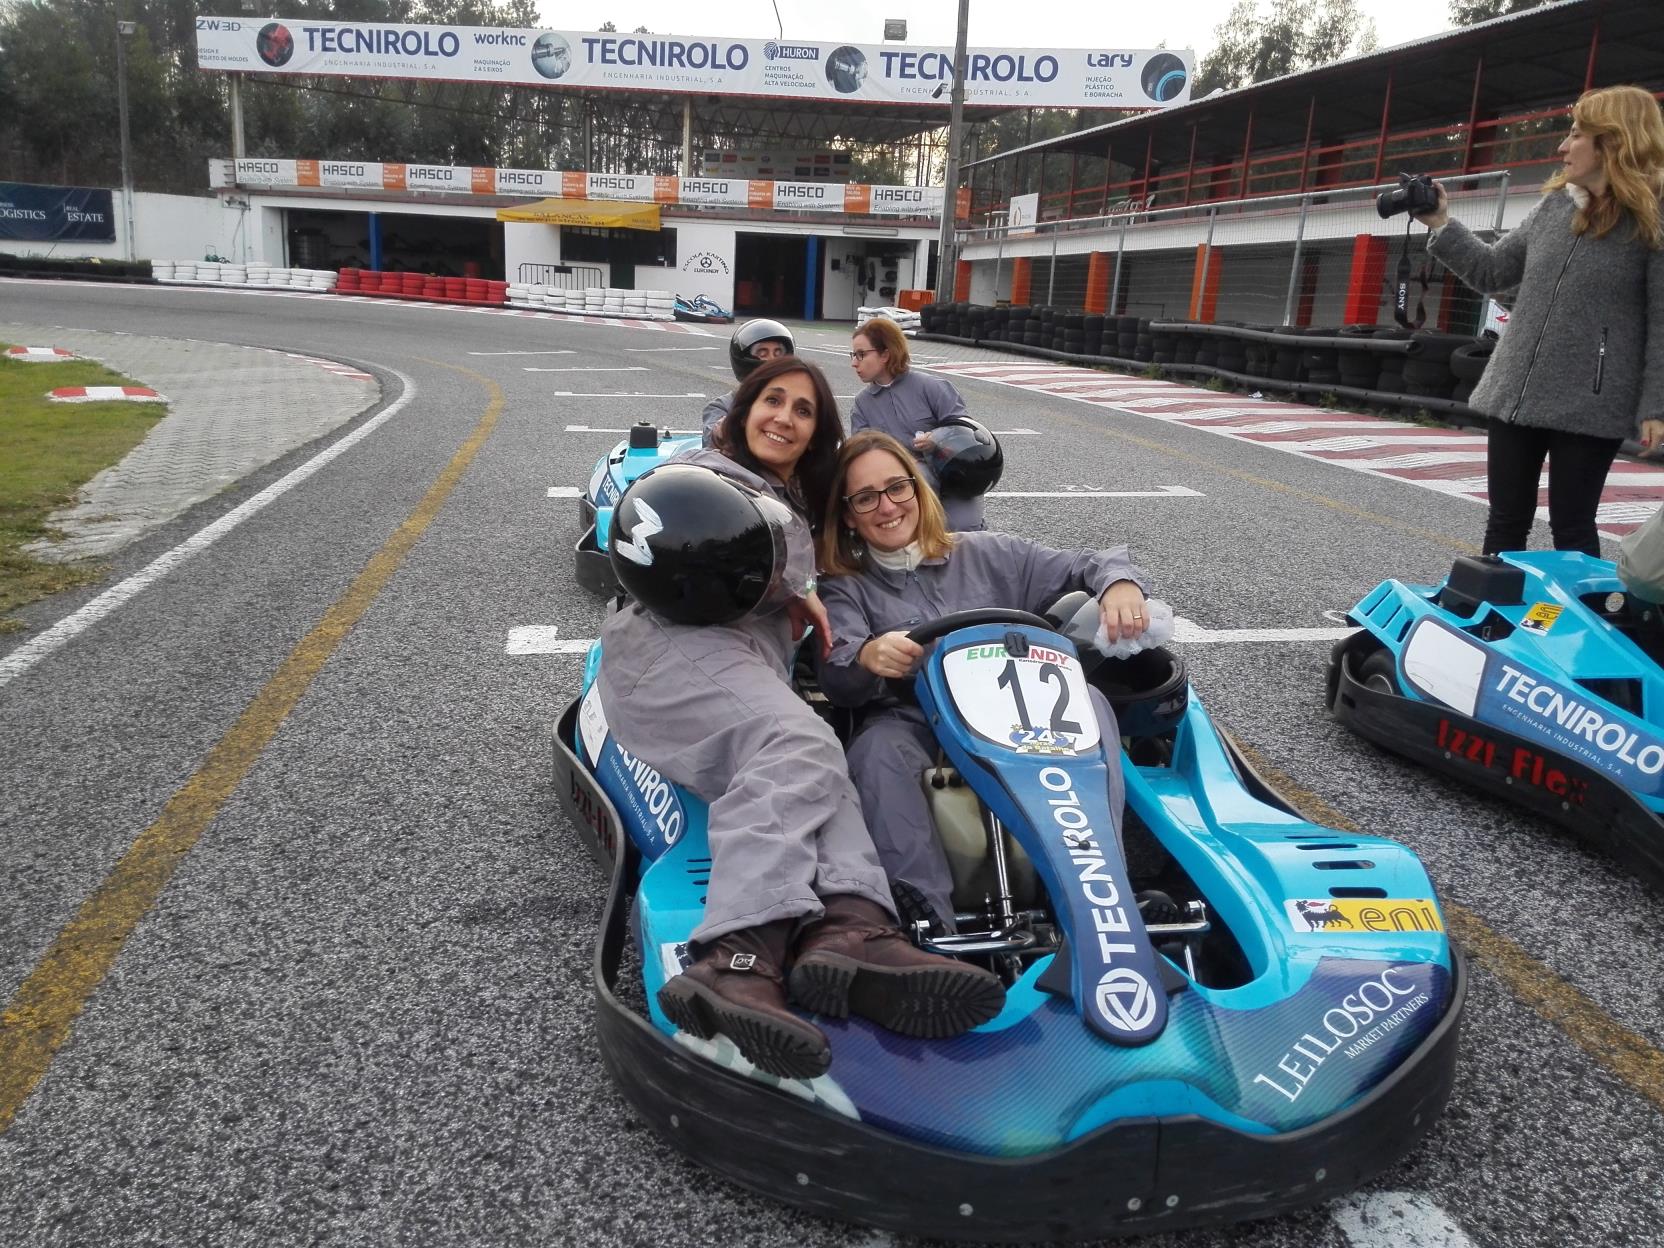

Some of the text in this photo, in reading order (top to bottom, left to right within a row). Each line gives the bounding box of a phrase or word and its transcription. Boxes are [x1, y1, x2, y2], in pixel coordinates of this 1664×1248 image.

[196, 19, 241, 31] ZW3D
[302, 27, 460, 58] TECNIROLO
[581, 37, 749, 71] TECNIROLO
[782, 47, 817, 59] HURON
[879, 51, 1059, 83] TECNIROLO
[603, 71, 653, 81] ENGENHARIA
[764, 73, 804, 81] MAQUINAÇÃO
[1085, 75, 1112, 83] INJEÇÃO
[238, 162, 278, 174] HASCO
[323, 164, 364, 176] HASCO
[409, 168, 453, 180] HASCO
[499, 172, 543, 185] HASCO
[590, 176, 635, 190] HASCO
[683, 181, 728, 194] HASCO
[777, 185, 824, 199] HASCO
[874, 189, 922, 202] HASCO
[0, 208, 46, 220] OGISTICS
[67, 212, 104, 223] ESTATE
[1398, 282, 1406, 311] SONY
[997, 659, 1083, 734] 12
[1496, 665, 1664, 774] TECNIROLO
[1502, 704, 1551, 735] ENGENHARIA
[1018, 729, 1057, 744] 24
[609, 755, 629, 793] ENGENHARIA
[1039, 766, 1137, 964] TECNIROLO
[1359, 899, 1440, 932] eni
[1343, 992, 1430, 1060] MARKET PARTNERS
[1253, 966, 1416, 1103] LEILOSOC
